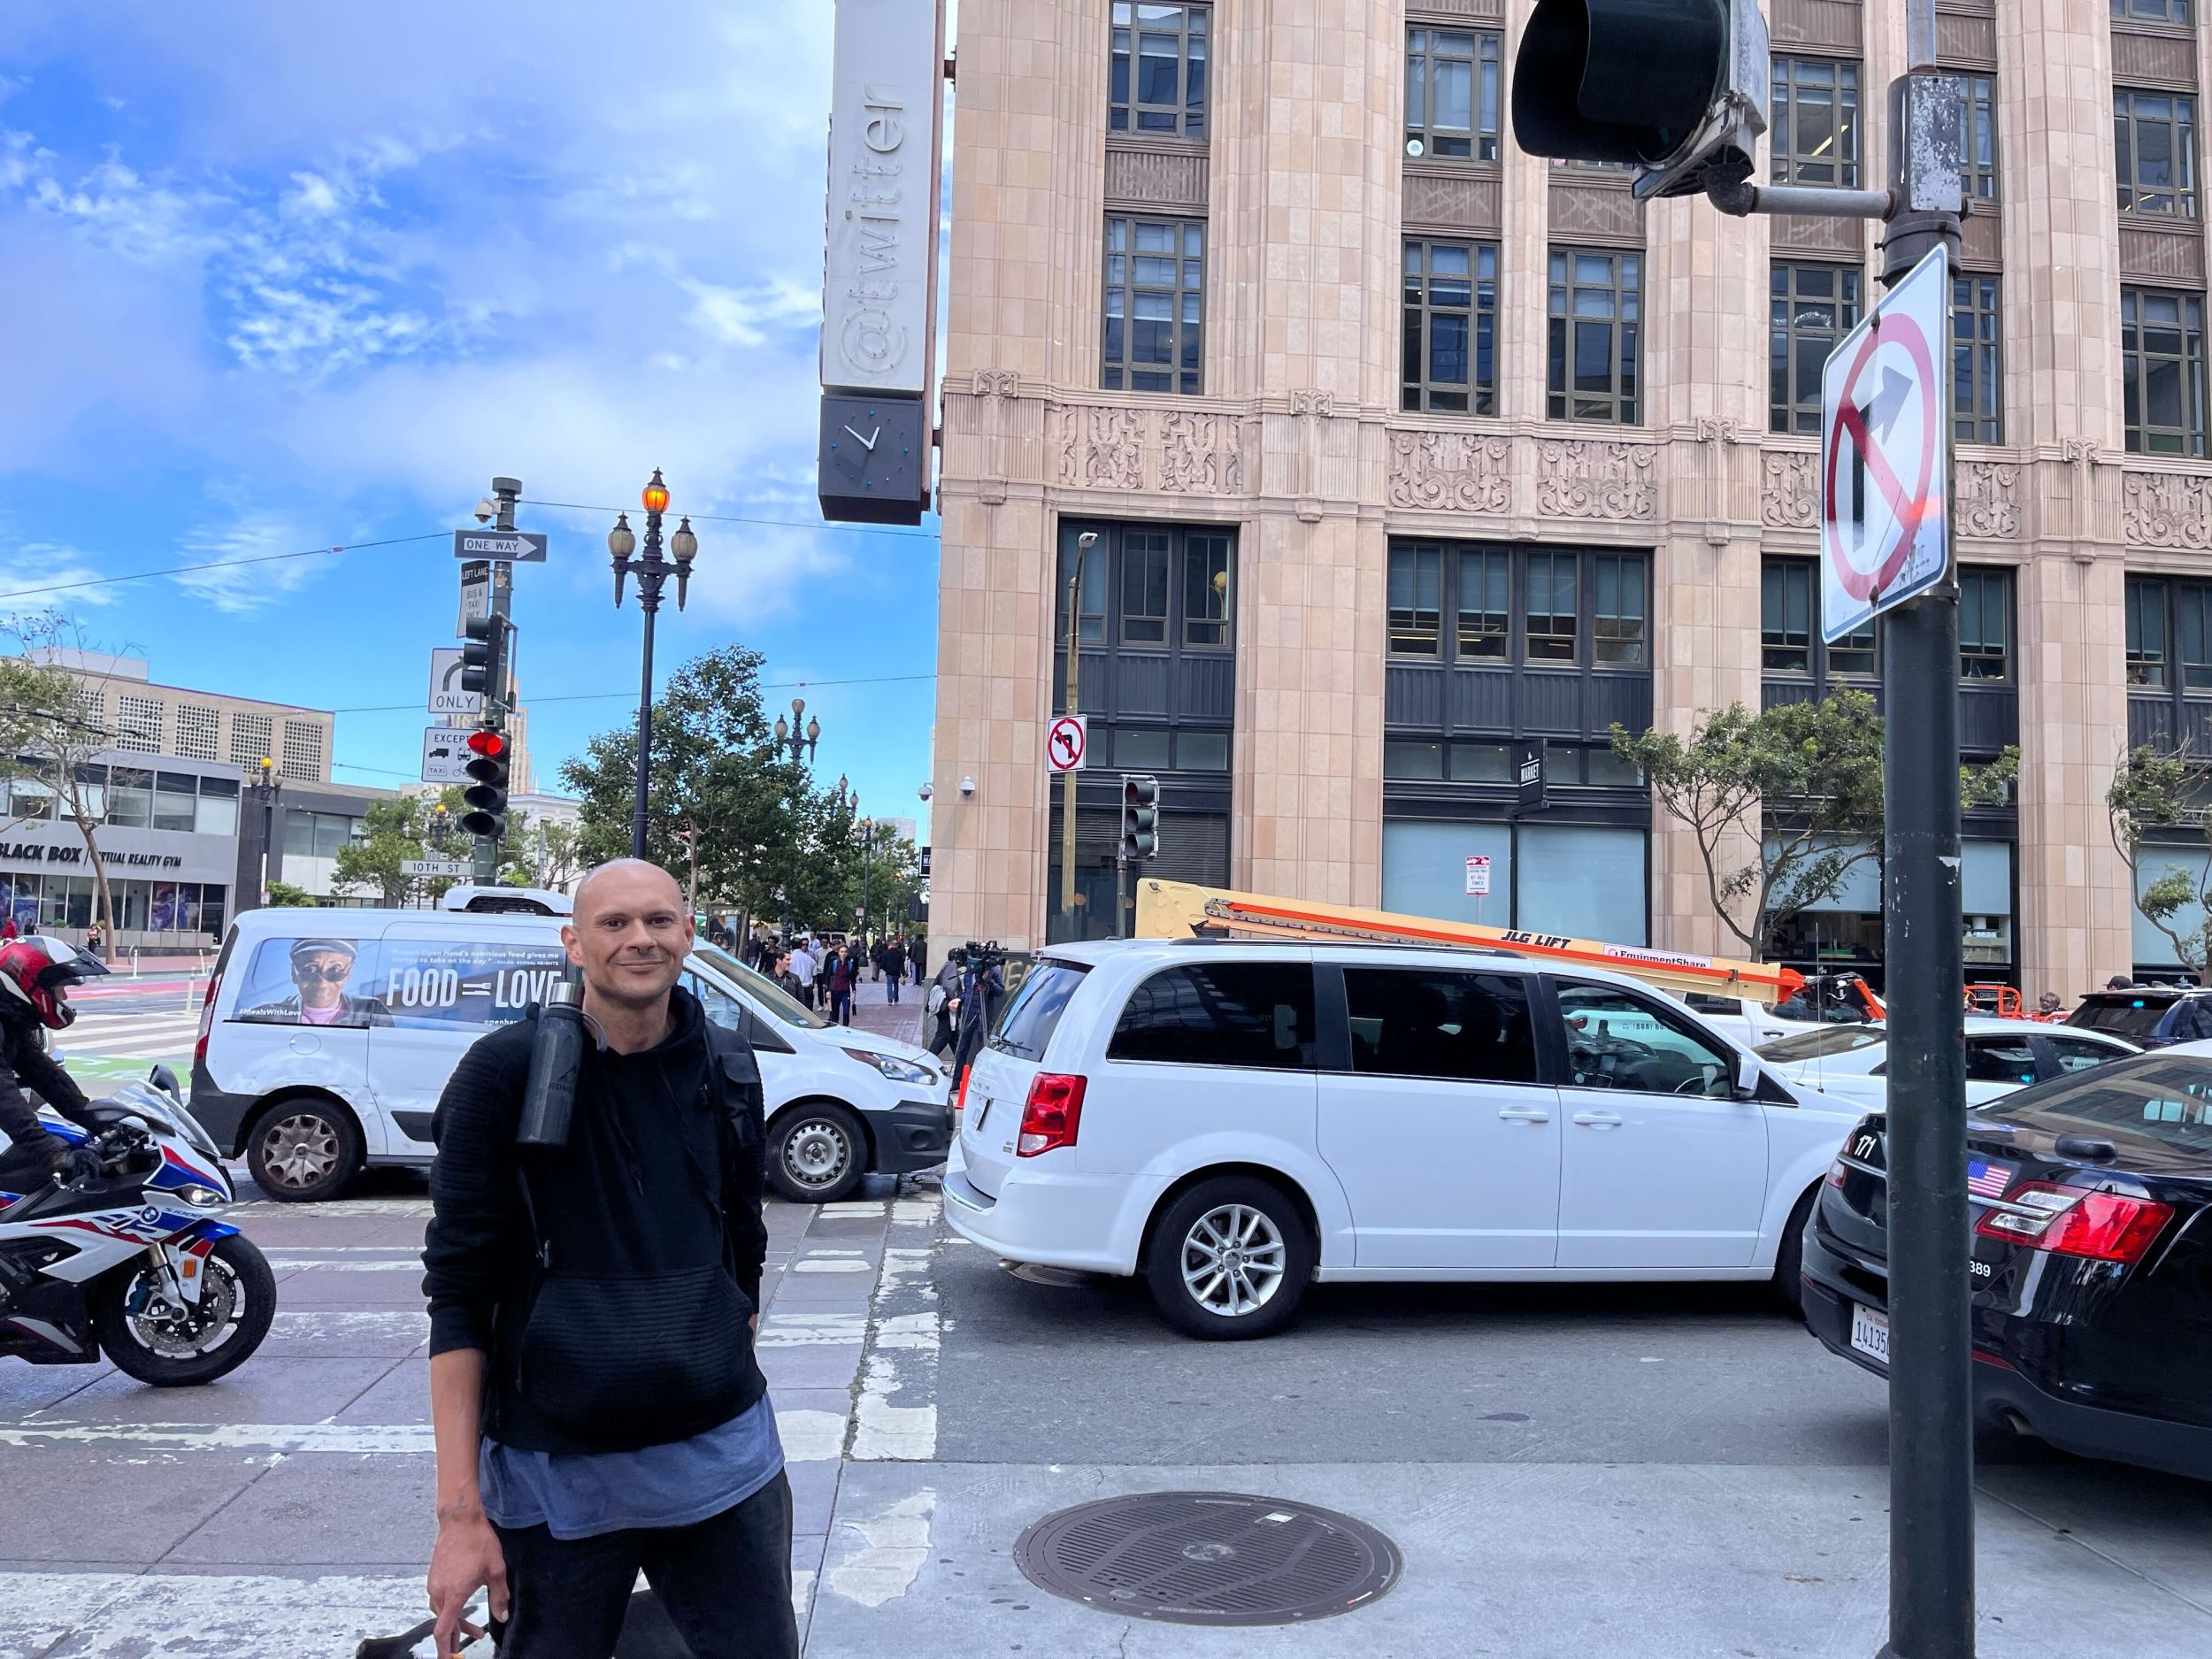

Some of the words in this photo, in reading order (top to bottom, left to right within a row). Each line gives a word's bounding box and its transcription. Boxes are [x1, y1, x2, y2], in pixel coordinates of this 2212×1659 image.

[841, 83, 907, 374] @twitter
[466, 540, 489, 550] ONE
[495, 540, 518, 551] WAY
[462, 570, 474, 580] LEFT
[474, 567, 488, 577] LANE
[466, 589, 477, 599] BUS
[478, 588, 482, 596] &
[436, 695, 474, 709] ONLY
[1520, 763, 1540, 783] MARKET
[47, 846, 83, 863] BOX
[128, 853, 162, 866] REALITY
[163, 856, 181, 867] GYM
[413, 863, 439, 872] 10TH
[447, 864, 460, 873] ST
[1501, 931, 1532, 943] JLG
[1534, 934, 1571, 949] LIFT
[386, 967, 458, 1007] FOOD
[1855, 1135, 1877, 1158] 171
[1970, 1261, 1991, 1277] 389
